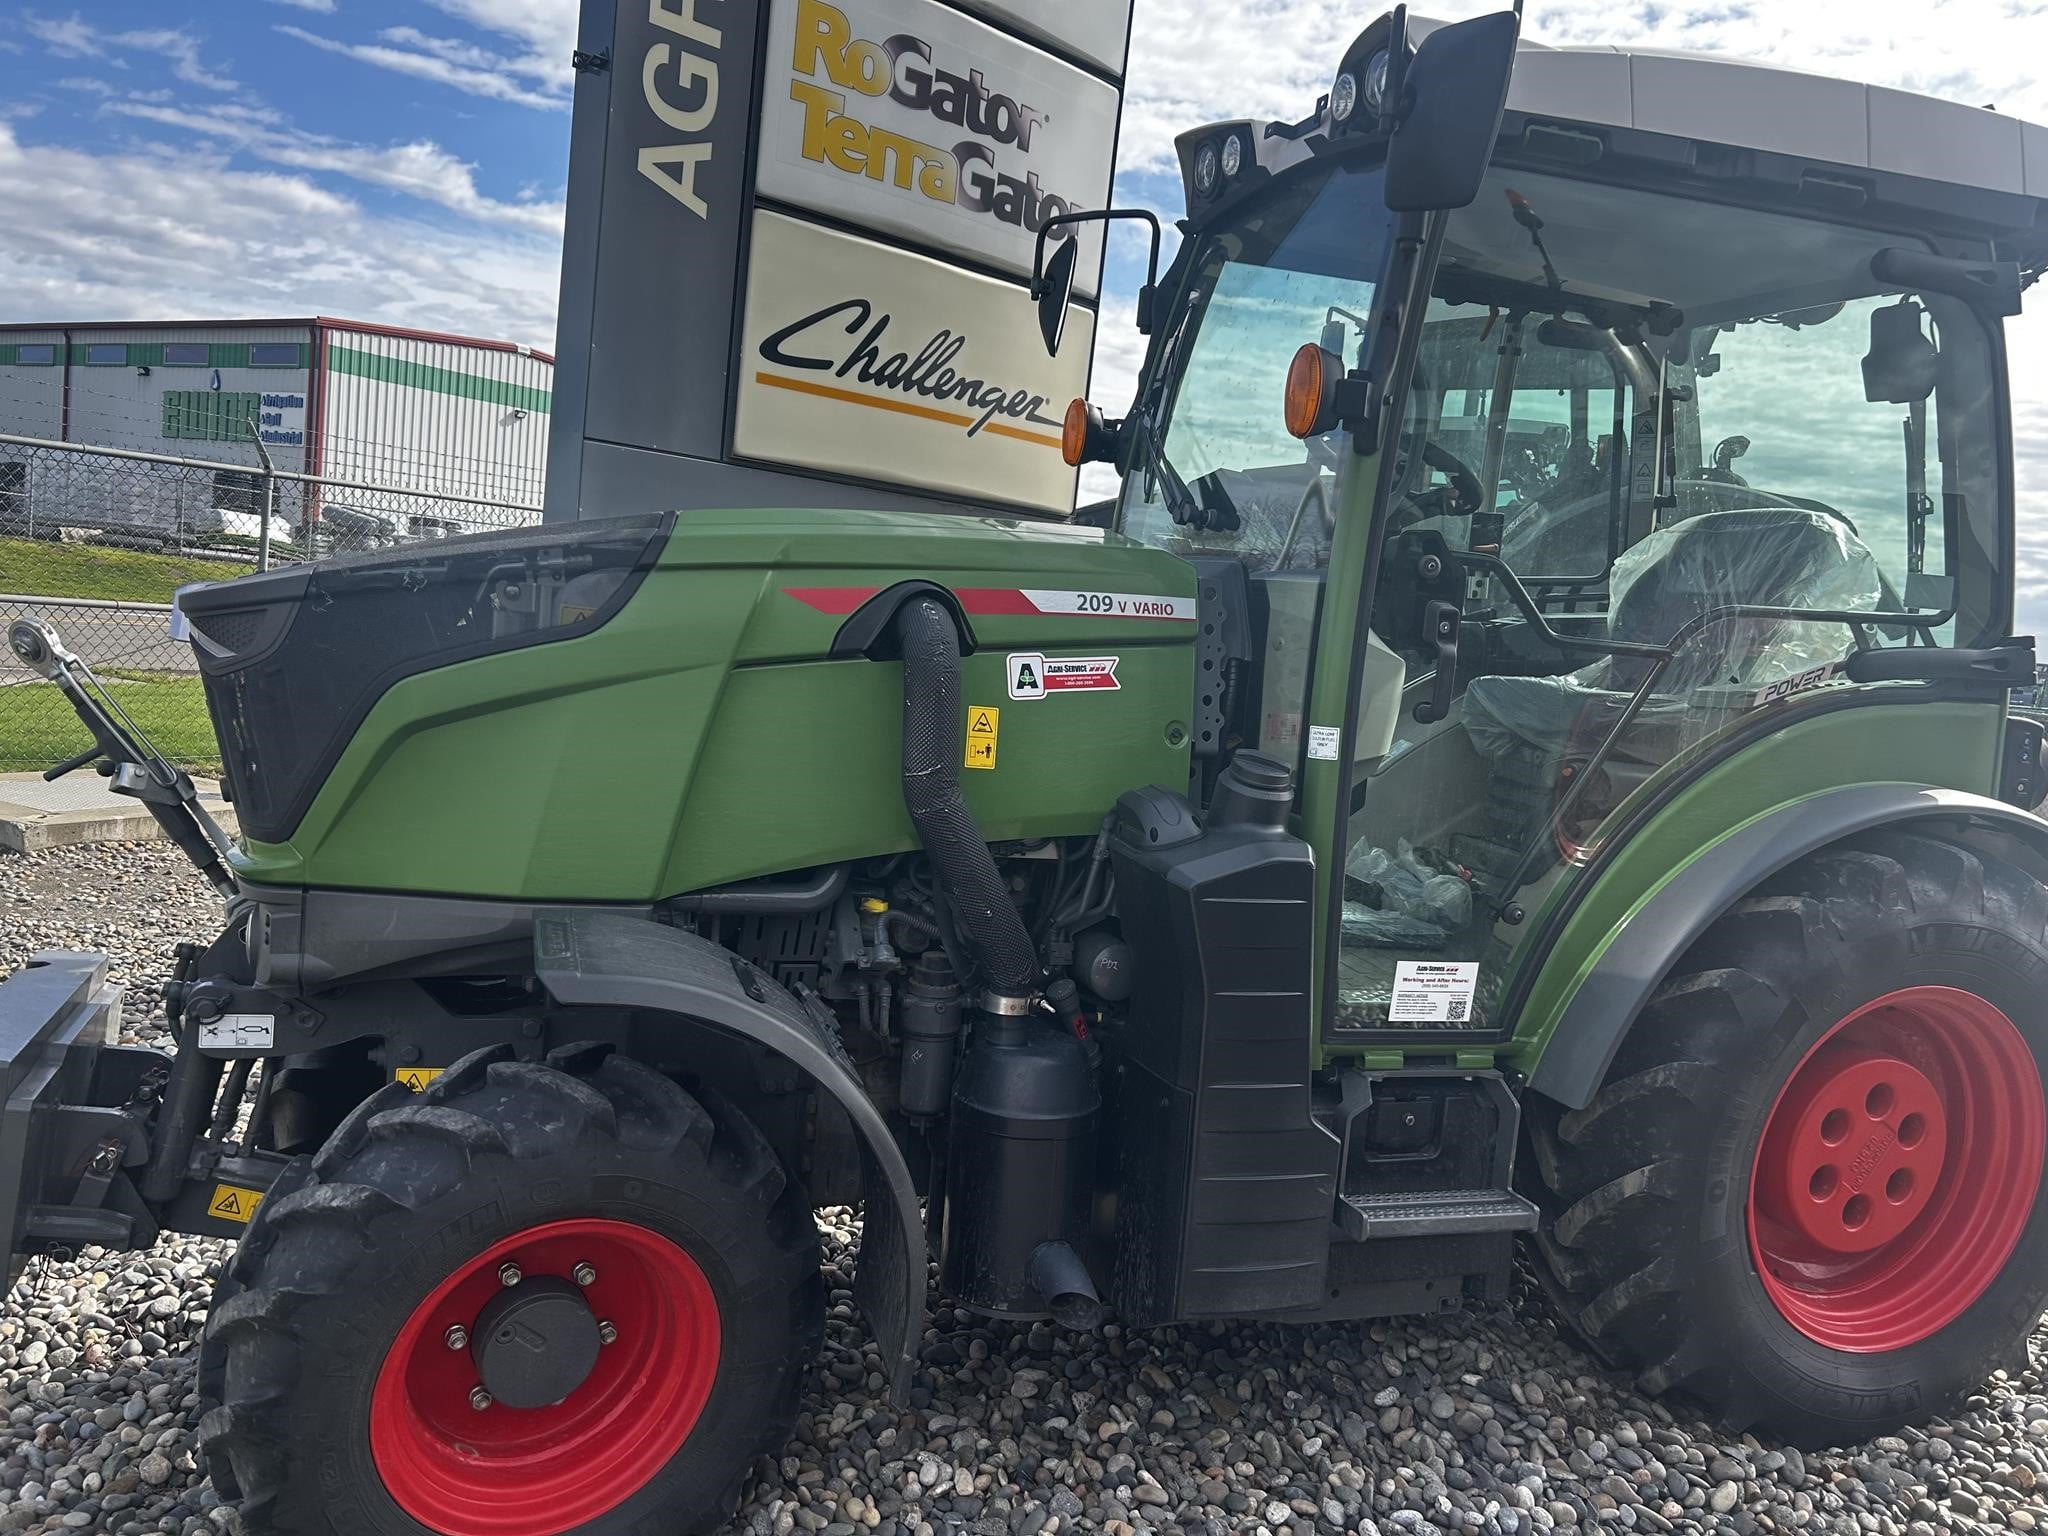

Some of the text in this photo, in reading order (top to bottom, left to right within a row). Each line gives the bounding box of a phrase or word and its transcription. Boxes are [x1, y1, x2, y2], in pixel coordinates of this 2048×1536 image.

[792, 0, 1043, 154] RoGator
[758, 298, 1064, 438] Challenger
[1077, 593, 1175, 616] 209 V VARIO
[1763, 666, 1826, 701] POWER
